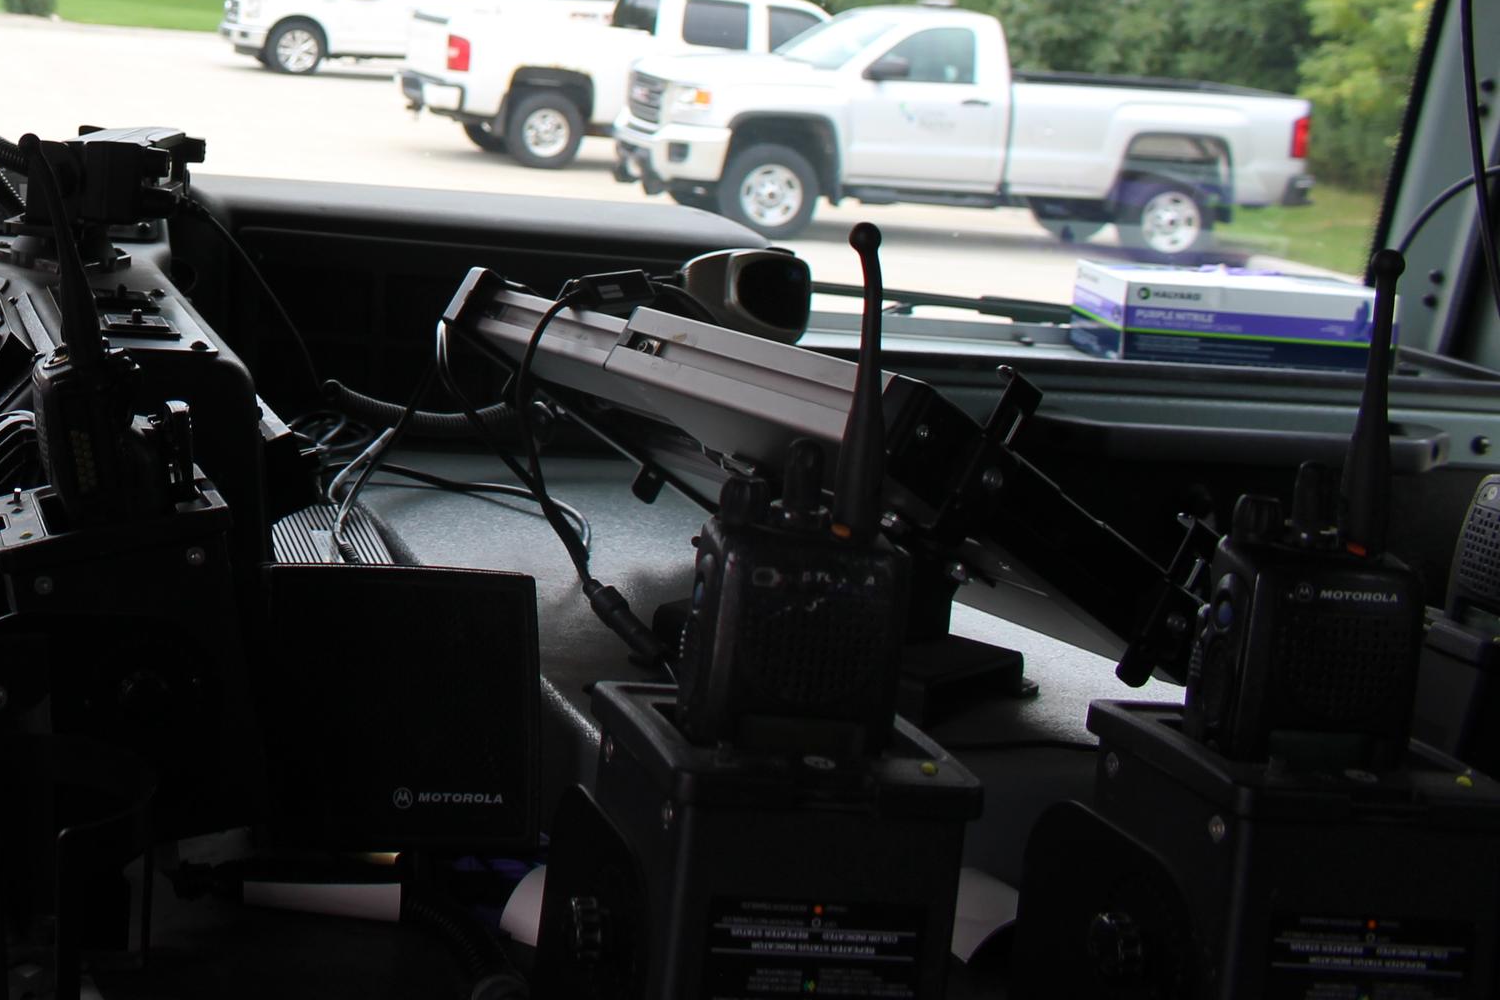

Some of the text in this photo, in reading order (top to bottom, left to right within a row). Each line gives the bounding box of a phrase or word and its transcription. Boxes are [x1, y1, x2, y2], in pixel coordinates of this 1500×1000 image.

[1135, 308, 1175, 320] PURPLE
[1319, 589, 1399, 603] MOTOROLA
[417, 791, 504, 805] MOTOROLA
[730, 927, 809, 940] REPEATER STATUS
[750, 941, 875, 955] REPEATER STATUS INDICATOR
